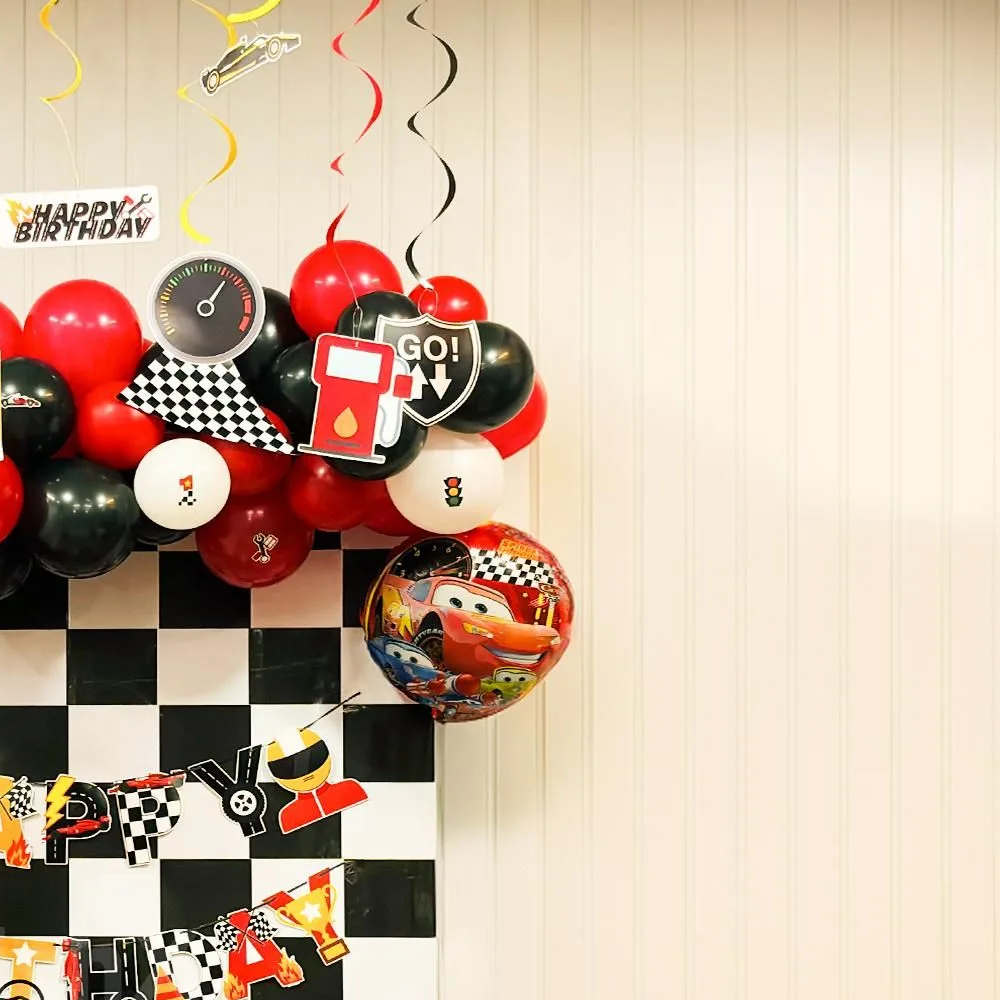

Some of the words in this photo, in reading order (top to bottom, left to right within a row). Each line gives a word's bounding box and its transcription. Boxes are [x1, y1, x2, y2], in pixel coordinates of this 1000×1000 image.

[31, 200, 127, 225] HAPPY
[14, 217, 151, 243] BIRTHDAY
[397, 333, 460, 362] GO!
